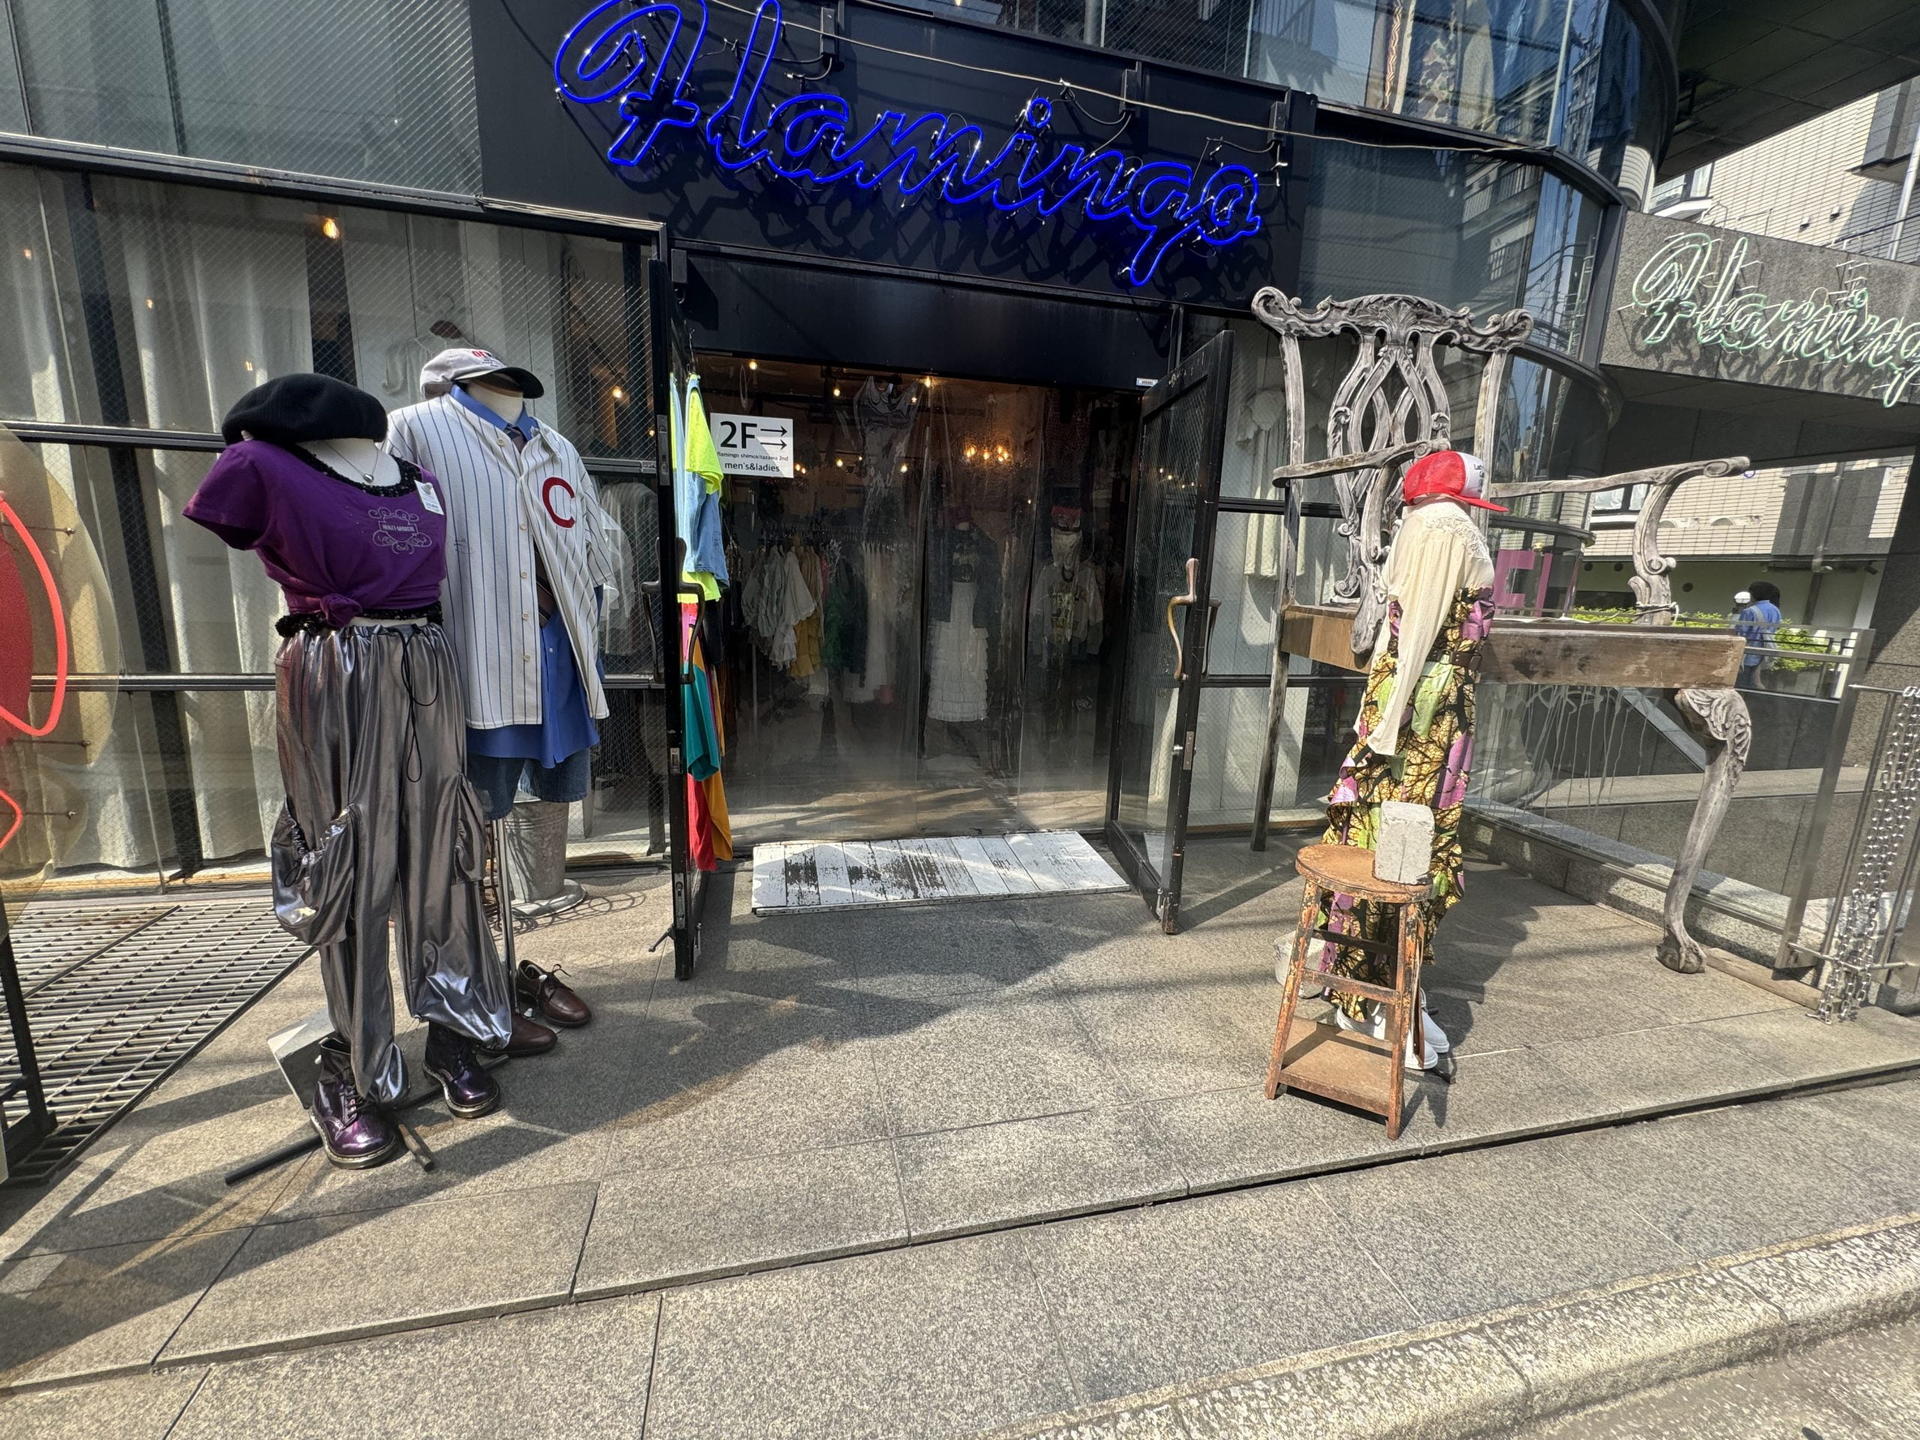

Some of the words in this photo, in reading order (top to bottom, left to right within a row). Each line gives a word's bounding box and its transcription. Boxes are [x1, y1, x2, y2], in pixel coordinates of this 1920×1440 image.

[554, 0, 1261, 286] Flamingo
[721, 421, 757, 448] 2F
[724, 462, 780, 472] men's&ladies
[543, 477, 575, 528] C
